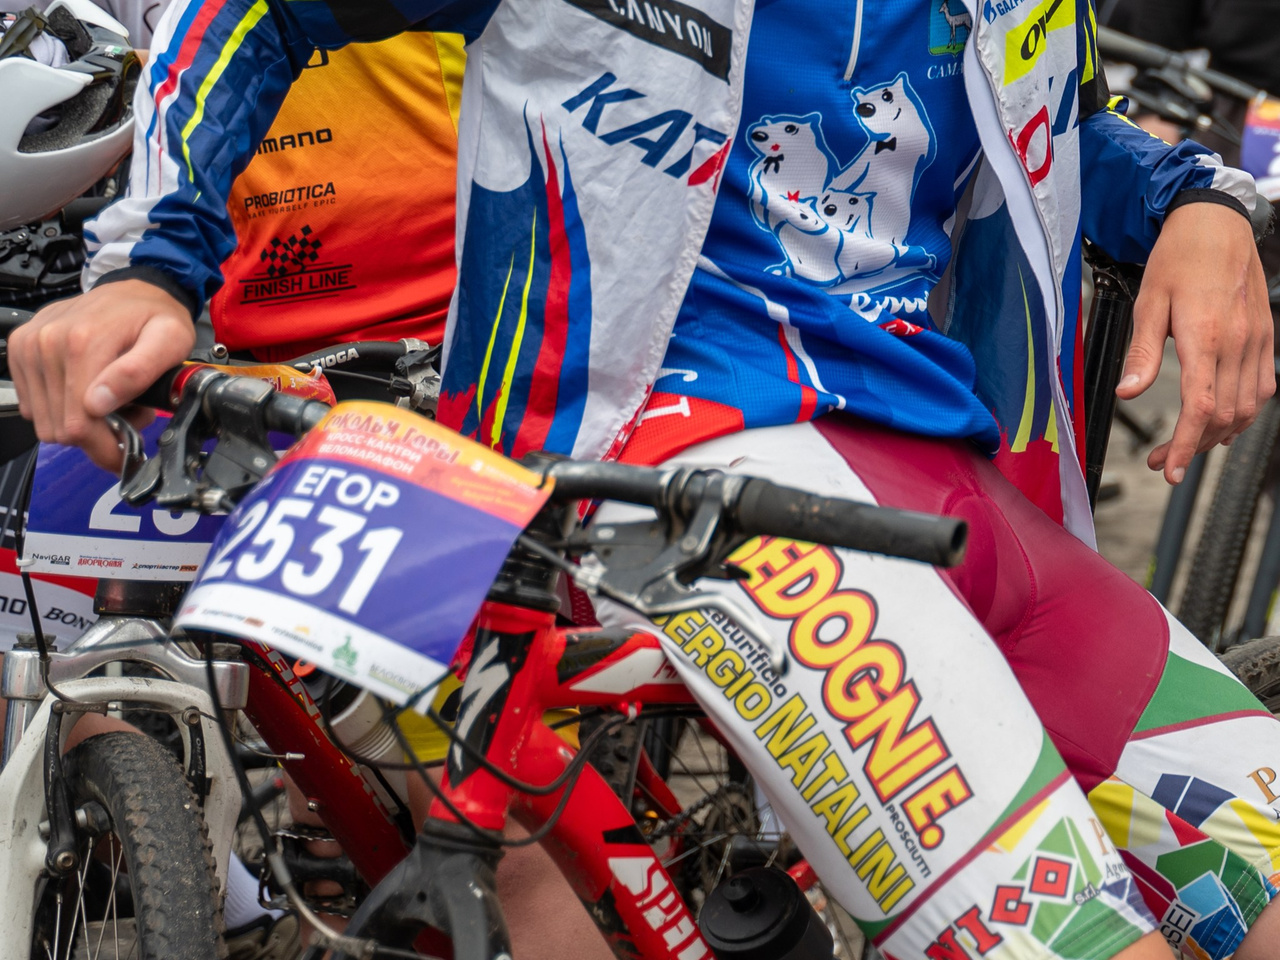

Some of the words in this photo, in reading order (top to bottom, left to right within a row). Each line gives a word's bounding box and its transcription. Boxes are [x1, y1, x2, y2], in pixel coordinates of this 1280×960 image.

[244, 181, 337, 213] PROBIOTICA
[243, 275, 304, 299] FINISH
[309, 270, 350, 290] LINE
[309, 347, 360, 369] TIOGA
[318, 443, 415, 476] ВЕЛОМАРАФОН
[325, 431, 422, 463] КРОСС-КАНТРИ
[294, 465, 401, 513] ЕГОР
[32, 552, 71, 563] NaviGAR
[200, 497, 404, 617] 2531
[754, 692, 917, 915] NATALINI
[884, 803, 932, 879] PROSCIUTTI
